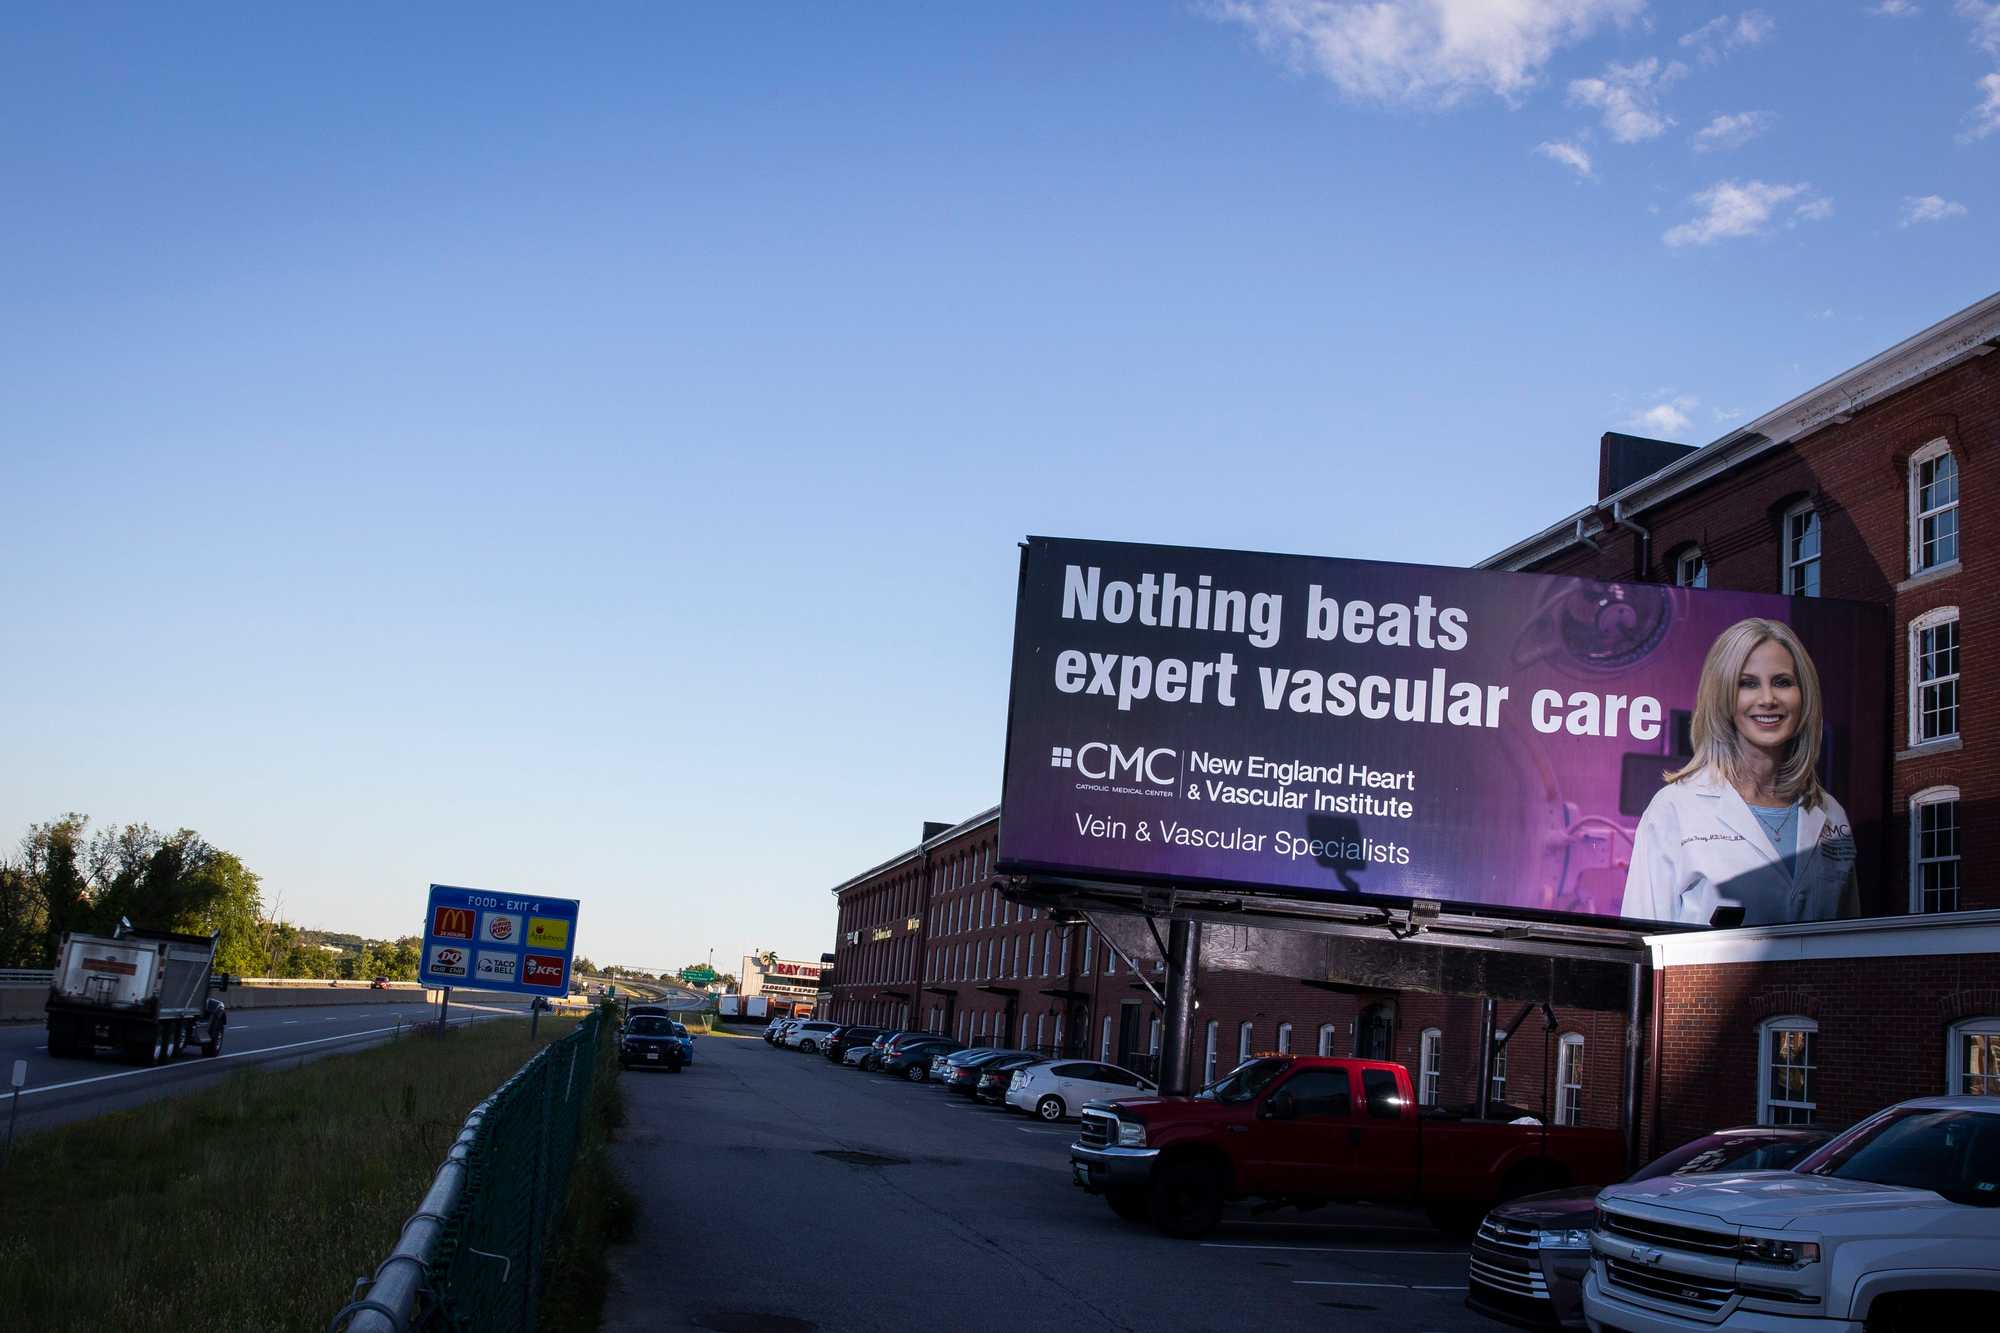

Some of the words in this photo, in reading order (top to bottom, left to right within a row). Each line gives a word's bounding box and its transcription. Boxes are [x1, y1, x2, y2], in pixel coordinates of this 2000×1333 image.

[1061, 564, 1282, 649] Nothing
[1306, 584, 1469, 652] beats
[1054, 648, 1238, 711] expert
[1259, 668, 1509, 729] vascular
[1530, 687, 1663, 741] care
[1076, 742, 1177, 786] CMC
[1190, 751, 1243, 776] New
[1248, 756, 1343, 787] England
[1348, 764, 1416, 791] Heart
[1075, 783, 1110, 793] CATHOLIC
[1112, 786, 1143, 796] MEDICAL
[1145, 788, 1174, 798] CENTER
[1187, 783, 1201, 800] &
[1205, 780, 1307, 810] Vascular
[1314, 786, 1414, 819] Institute
[1075, 813, 1127, 840] Vein
[1135, 821, 1151, 842] &
[1160, 820, 1267, 853] Vascular
[1274, 830, 1411, 865] Specialists
[468, 895, 497, 908] FOOD
[506, 900, 529, 912] EXIT
[532, 903, 540, 913] 4
[492, 926, 512, 934] KING
[441, 950, 461, 962] DQ
[494, 960, 515, 969] TACO
[494, 967, 514, 975] BELL
[537, 966, 561, 976] KFC
[777, 963, 800, 975] RAY
[804, 967, 820, 977] THE
